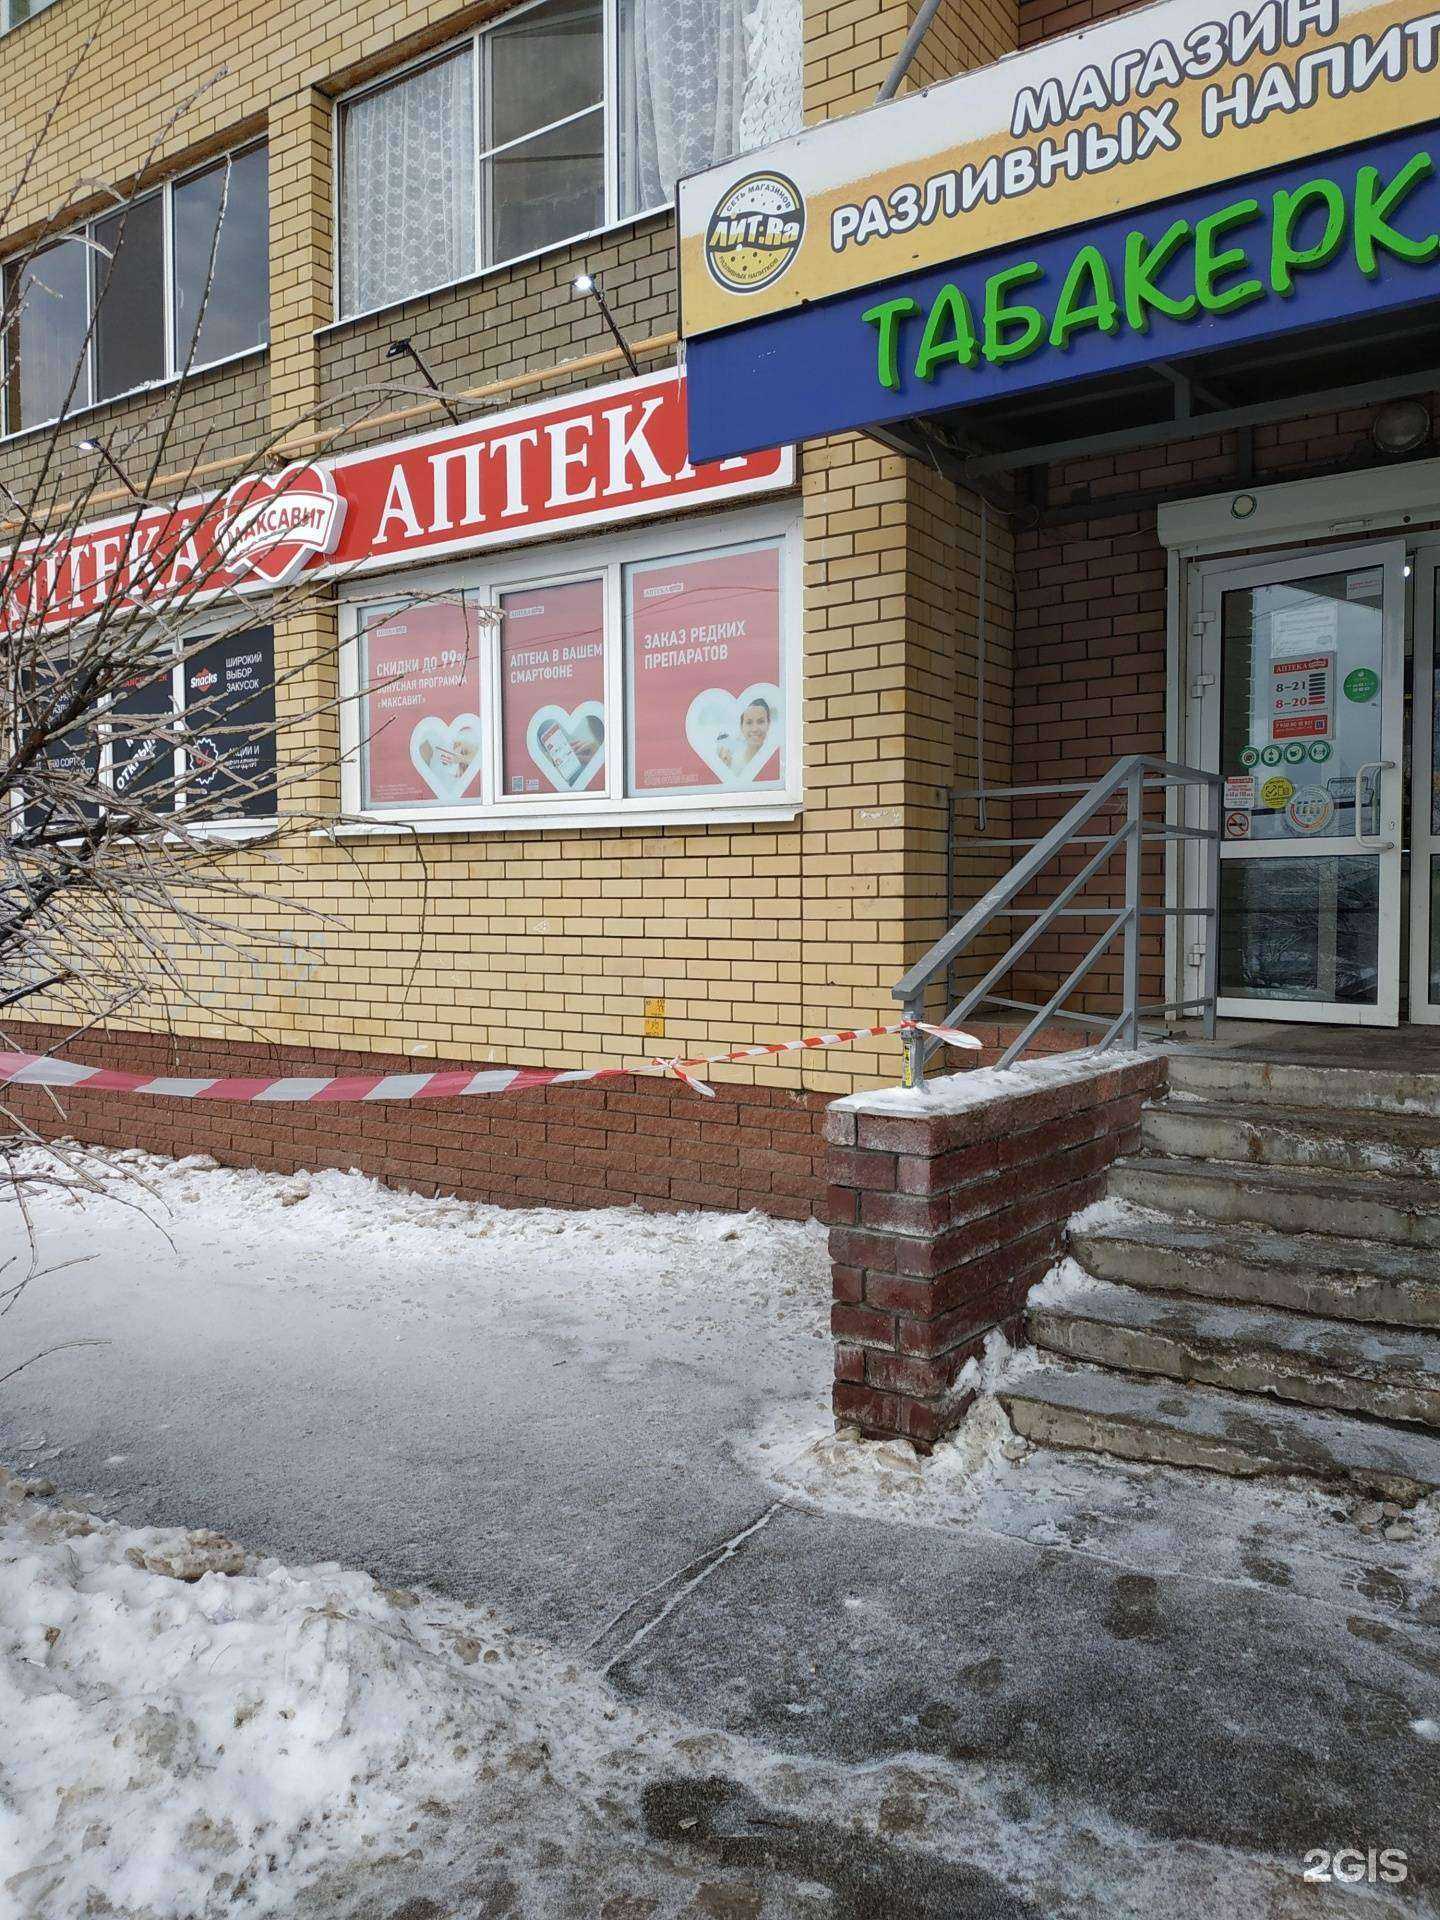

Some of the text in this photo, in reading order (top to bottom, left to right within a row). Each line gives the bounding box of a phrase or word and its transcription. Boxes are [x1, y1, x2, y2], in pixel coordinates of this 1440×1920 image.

[1010, 0, 1339, 137] МАГАЗИН
[830, 11, 1440, 253] РАЗЛИВНЫХ НАПИТ
[726, 183, 791, 212] СЕТЬ МАГАЗИНОВ
[861, 152, 1440, 390] ТАБАКЕРК
[372, 396, 747, 544] АПТЕК
[644, 619, 746, 649] ЗАКАЗ РЕДКИХ
[225, 651, 262, 667] ШИРОКИЙ
[376, 650, 466, 676] СКИДКИ ДО 99%
[510, 643, 603, 667] АПТЕКА В ВАШЕМ
[644, 644, 728, 670] ПРЕПАРАТОВ
[190, 673, 218, 688] Snacks
[226, 667, 252, 680] ВЫБОР
[226, 679, 260, 693] ЗАКУСОК
[419, 675, 468, 690] ПРОГРАММА
[510, 664, 573, 684] СМАРТФОНЕ
